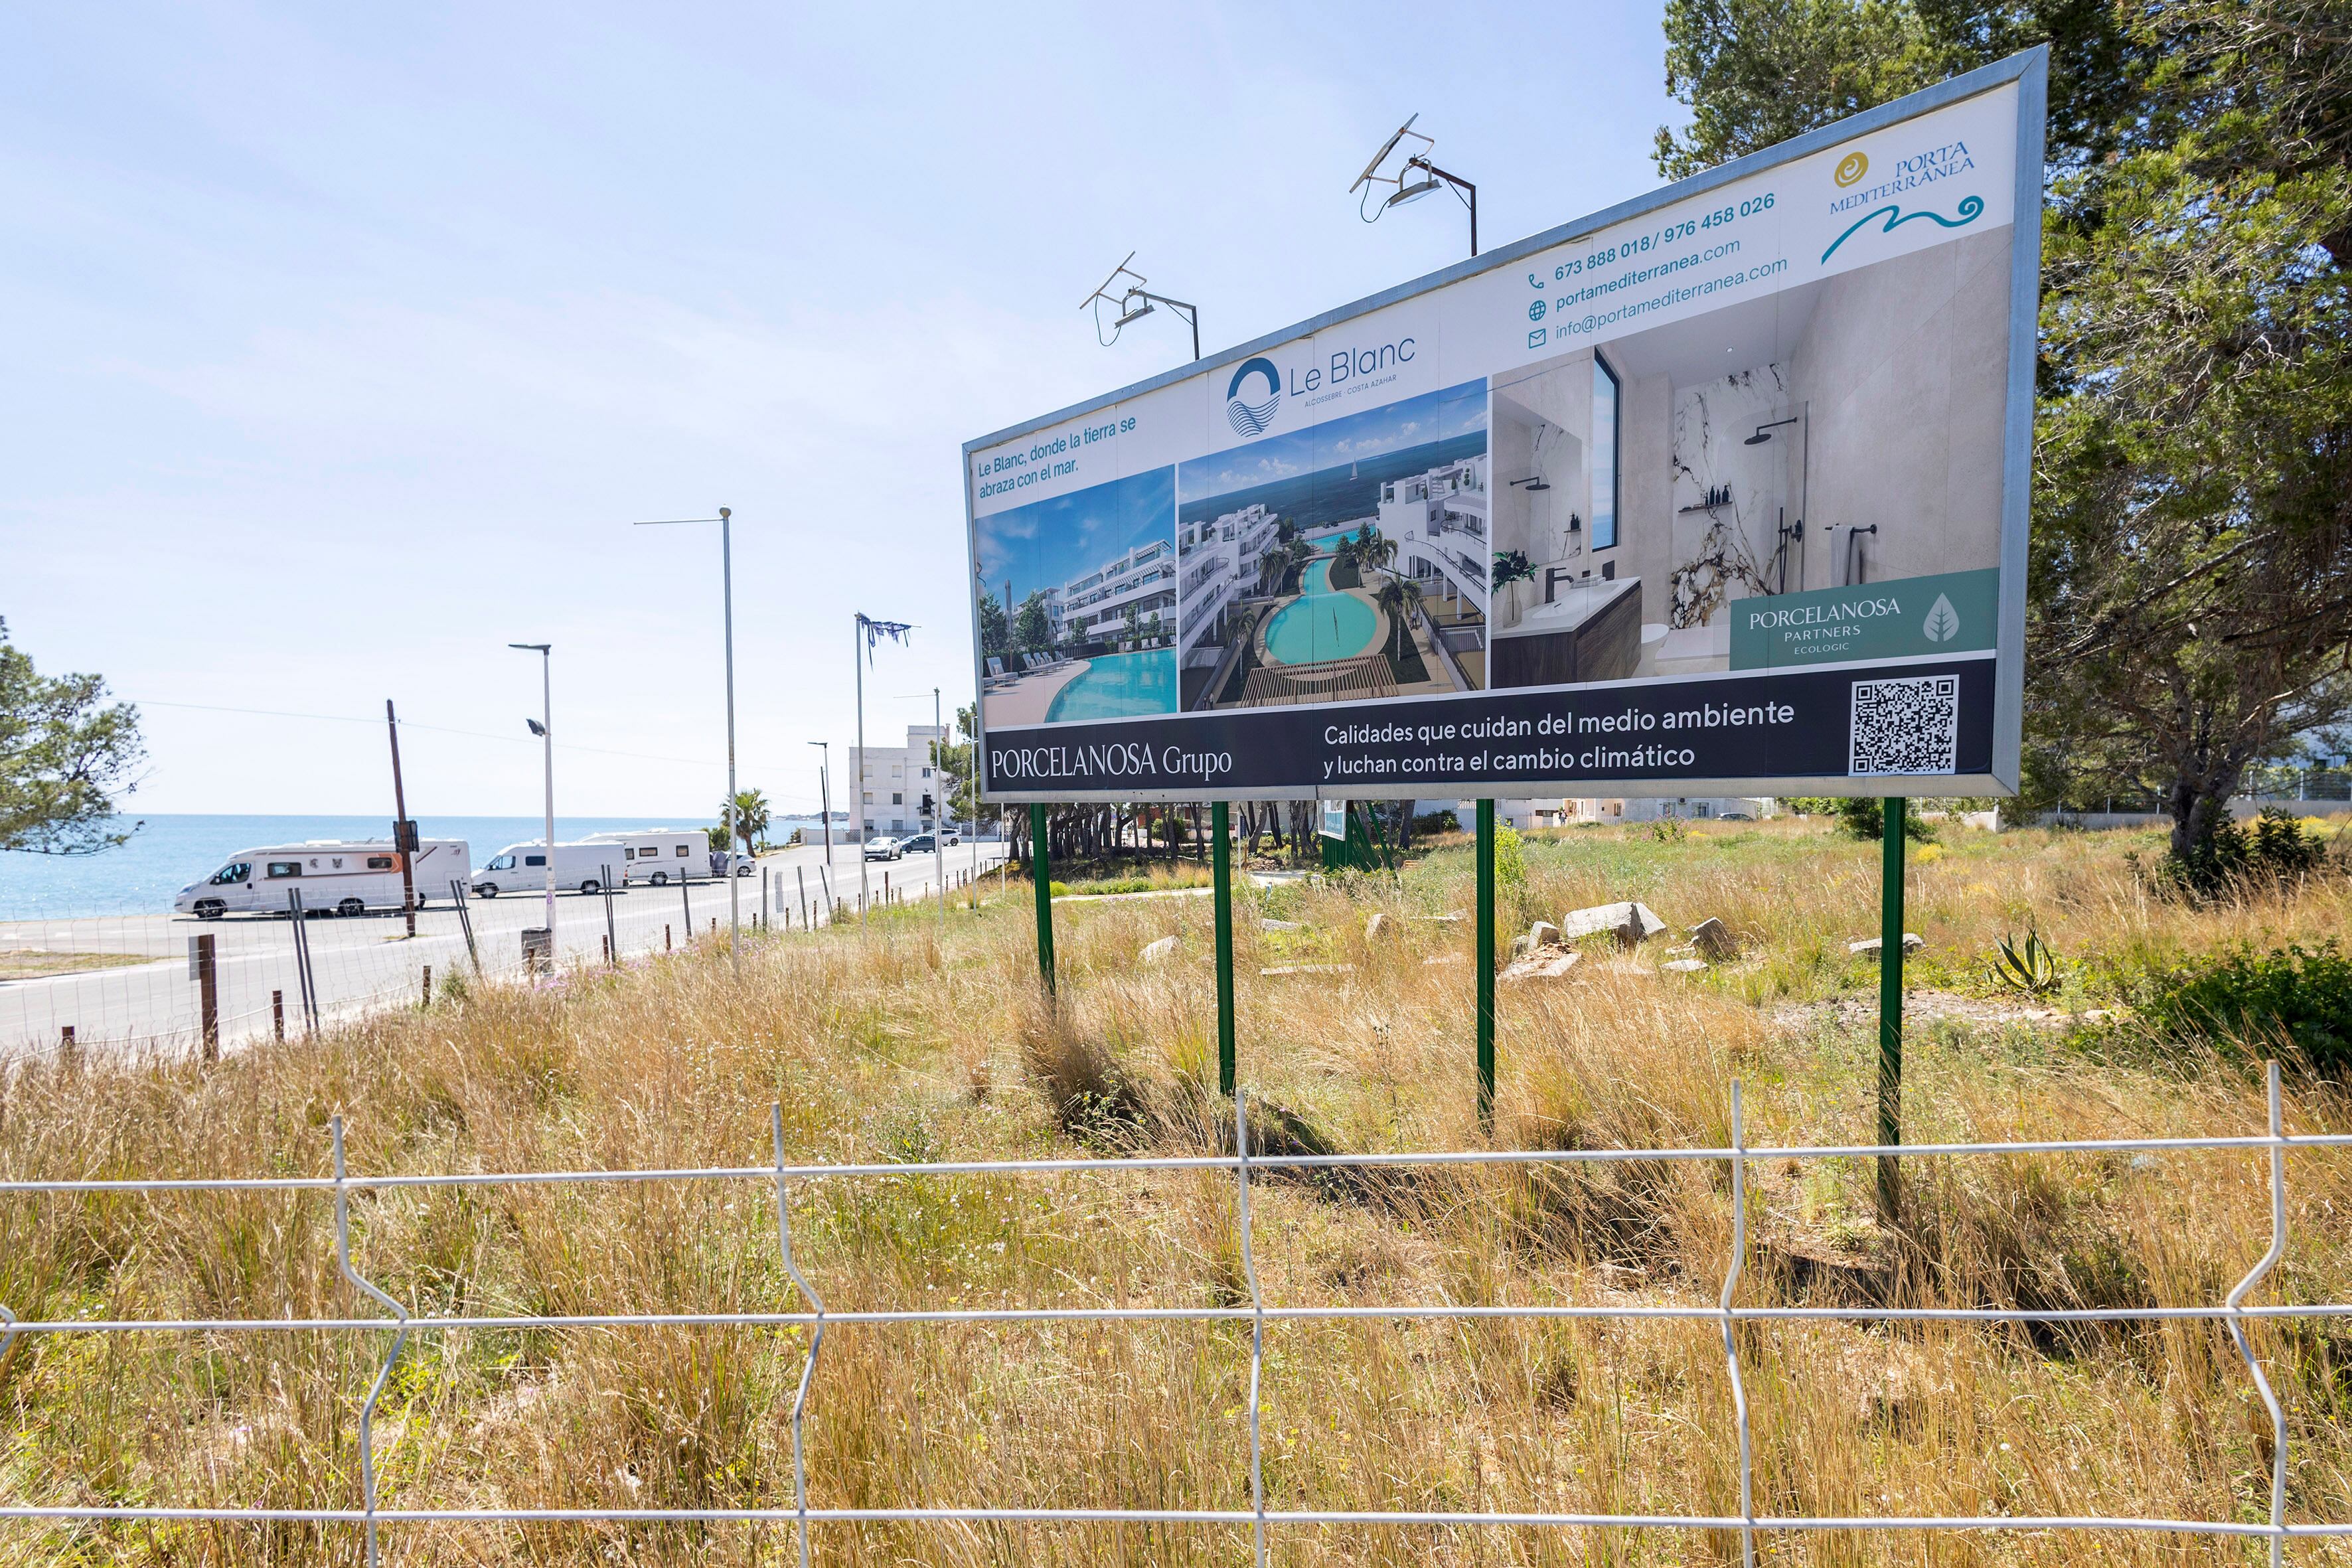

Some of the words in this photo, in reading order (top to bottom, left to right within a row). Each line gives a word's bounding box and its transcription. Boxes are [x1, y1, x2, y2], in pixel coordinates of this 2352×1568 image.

[1895, 141, 1969, 177] PORTA
[1830, 157, 1975, 215] MEDITERRÁNEA
[1555, 260, 1583, 280] 673
[1587, 248, 1616, 270] 888
[1620, 232, 1660, 258] 018/
[1664, 220, 1696, 243] 976
[1701, 206, 1735, 229] 458
[1740, 193, 1775, 218] 026
[1556, 239, 1741, 312] portamediterranea.com
[1556, 257, 1788, 339] info@portamediterranea.com
[1291, 368, 1321, 397] Le
[1331, 338, 1415, 384] Blanc
[1304, 390, 1342, 408] ALCOSSEBRE
[1347, 382, 1370, 395] COSTA
[1371, 374, 1397, 388] AZAHAR
[979, 463, 991, 477] Le
[994, 453, 1027, 473] Blanc,
[1030, 438, 1067, 461] donde
[1069, 433, 1081, 449] la
[1083, 423, 1116, 443] tierra
[1120, 417, 1136, 433] se
[980, 478, 1015, 499] abraza
[1017, 471, 1038, 488] con
[1040, 463, 1051, 481] el
[1054, 459, 1079, 477] mar.
[1750, 597, 1901, 629] PORCELANOSA
[1784, 625, 1861, 643] PARTNERS
[1794, 642, 1849, 655] ECOLOGIC
[1324, 722, 1413, 745] Calidades
[1417, 724, 1456, 745] que
[1460, 716, 1531, 739] cuidan
[1537, 712, 1572, 735] del
[1579, 708, 1656, 734] medio
[1662, 701, 1794, 730] ambiente
[991, 742, 1157, 778] PORCELANOSA
[1162, 746, 1232, 781] Grupo
[1324, 761, 1334, 779] y
[1338, 754, 1397, 774] luchan
[1401, 753, 1464, 773] contra
[1469, 750, 1488, 771] el
[1493, 747, 1575, 770] cambio
[1580, 744, 1695, 768] climático
